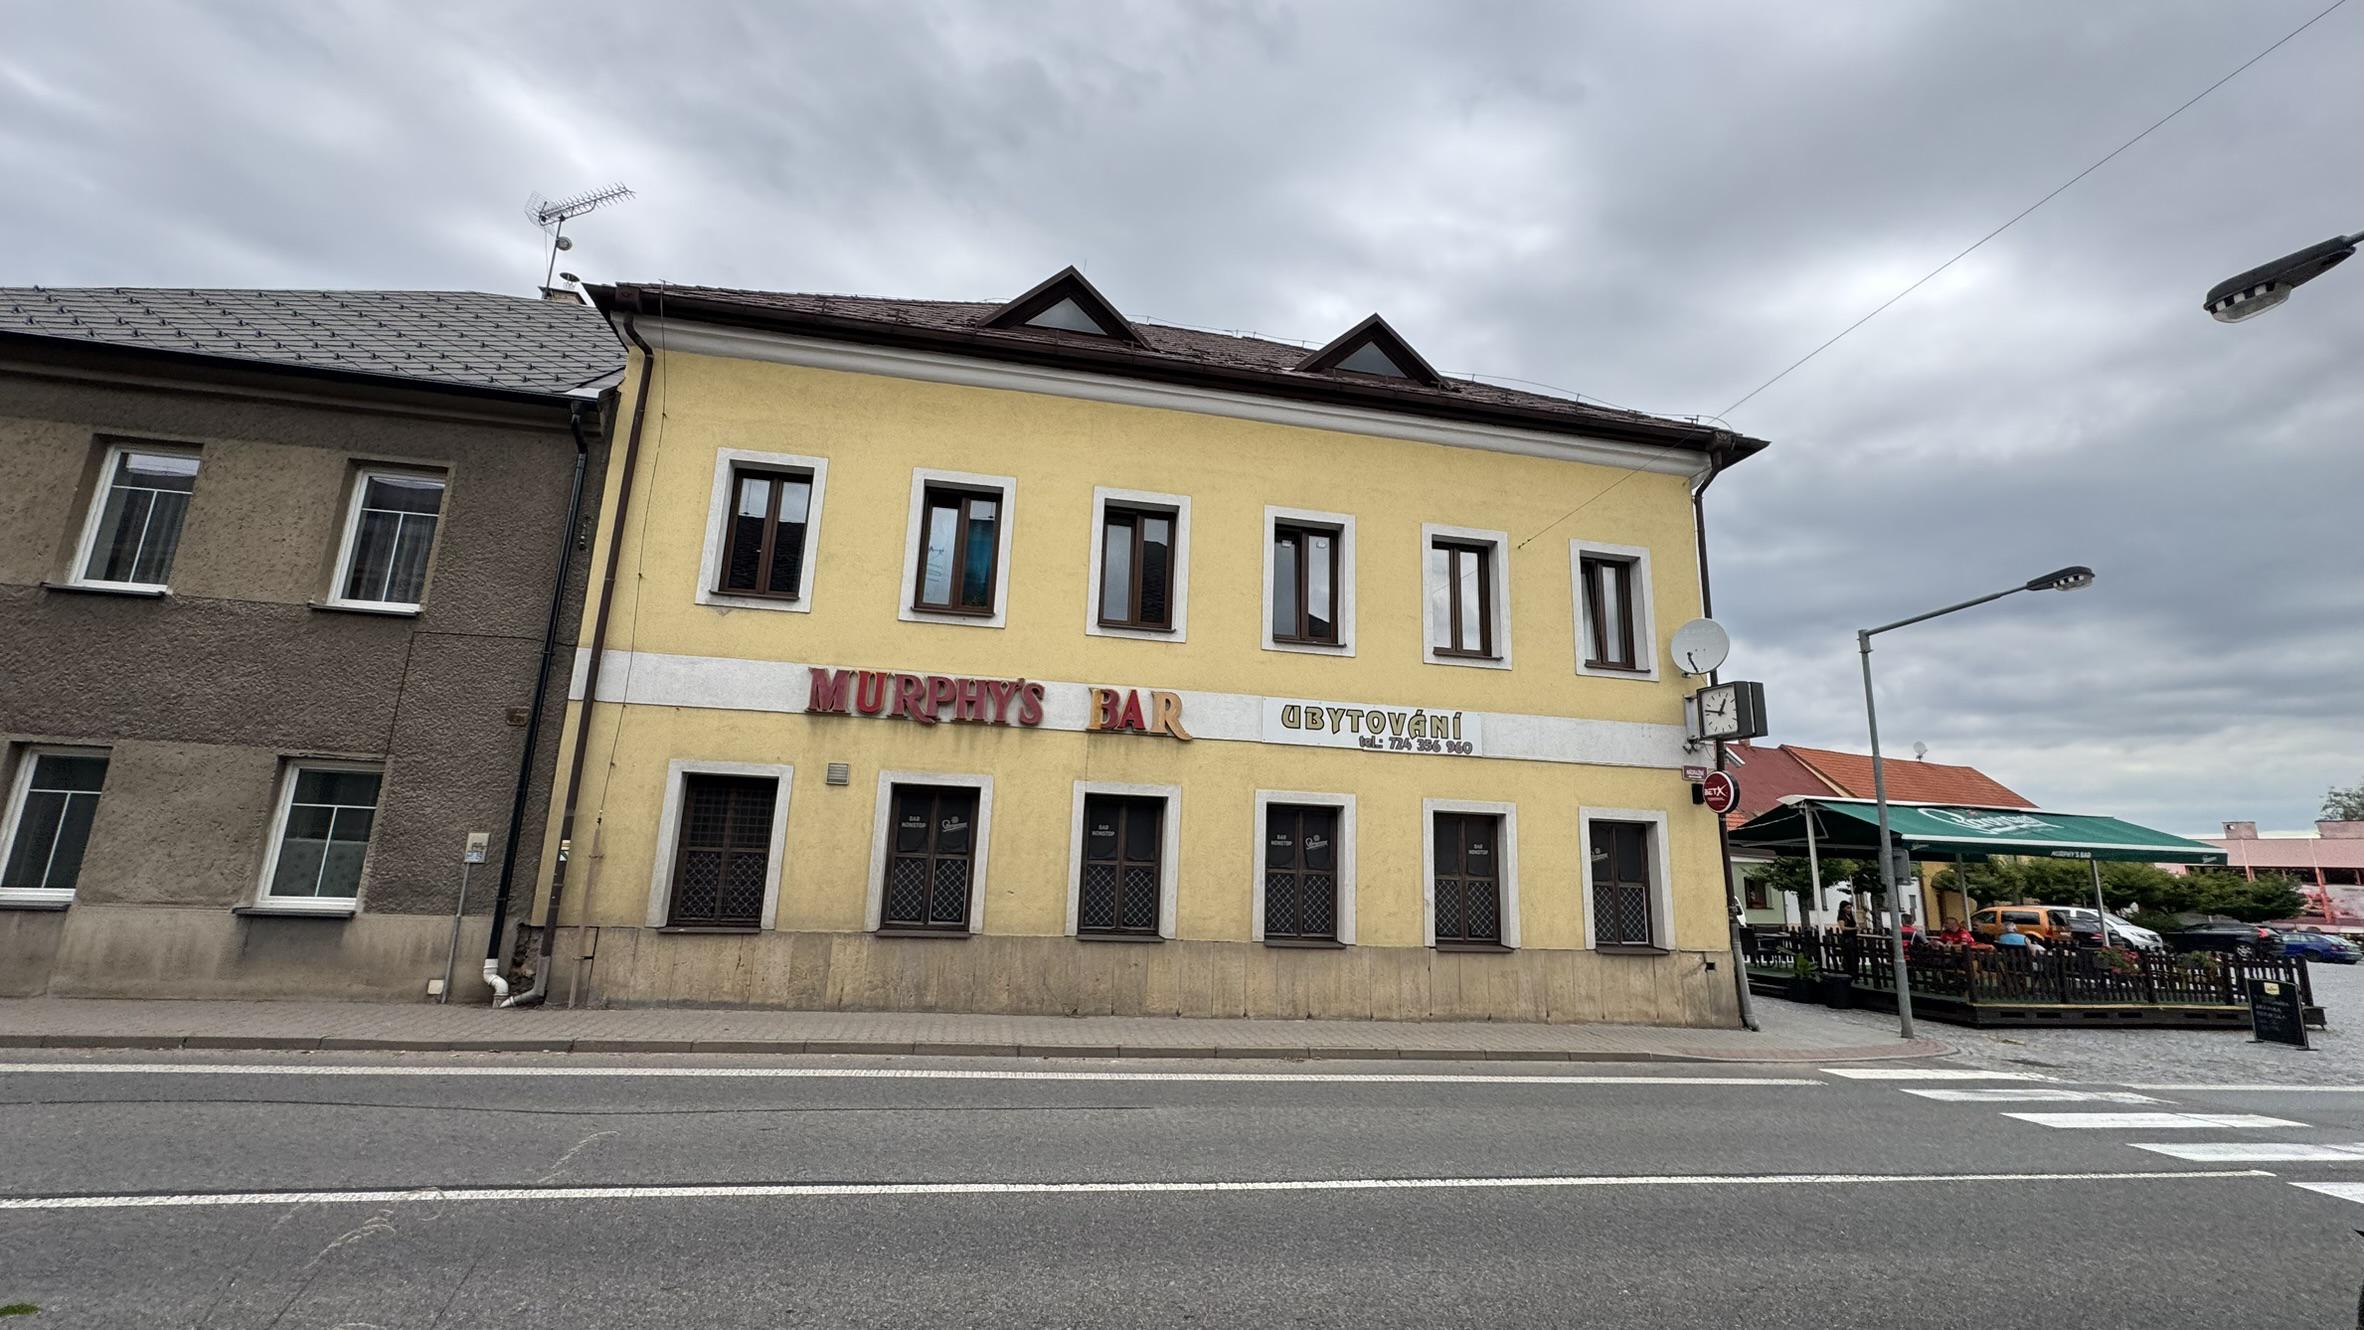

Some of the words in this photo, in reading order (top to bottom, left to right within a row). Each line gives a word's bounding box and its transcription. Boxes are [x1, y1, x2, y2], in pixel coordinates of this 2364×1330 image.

[804, 666, 1046, 726] MURPHY'S
[1087, 687, 1193, 742] BAR
[1281, 704, 1463, 741] UBYTOVÁNÍ
[1358, 735, 1384, 749] tel.:
[1388, 736, 1413, 751] 724
[1416, 738, 1442, 753] 356
[1446, 740, 1473, 755] 960
